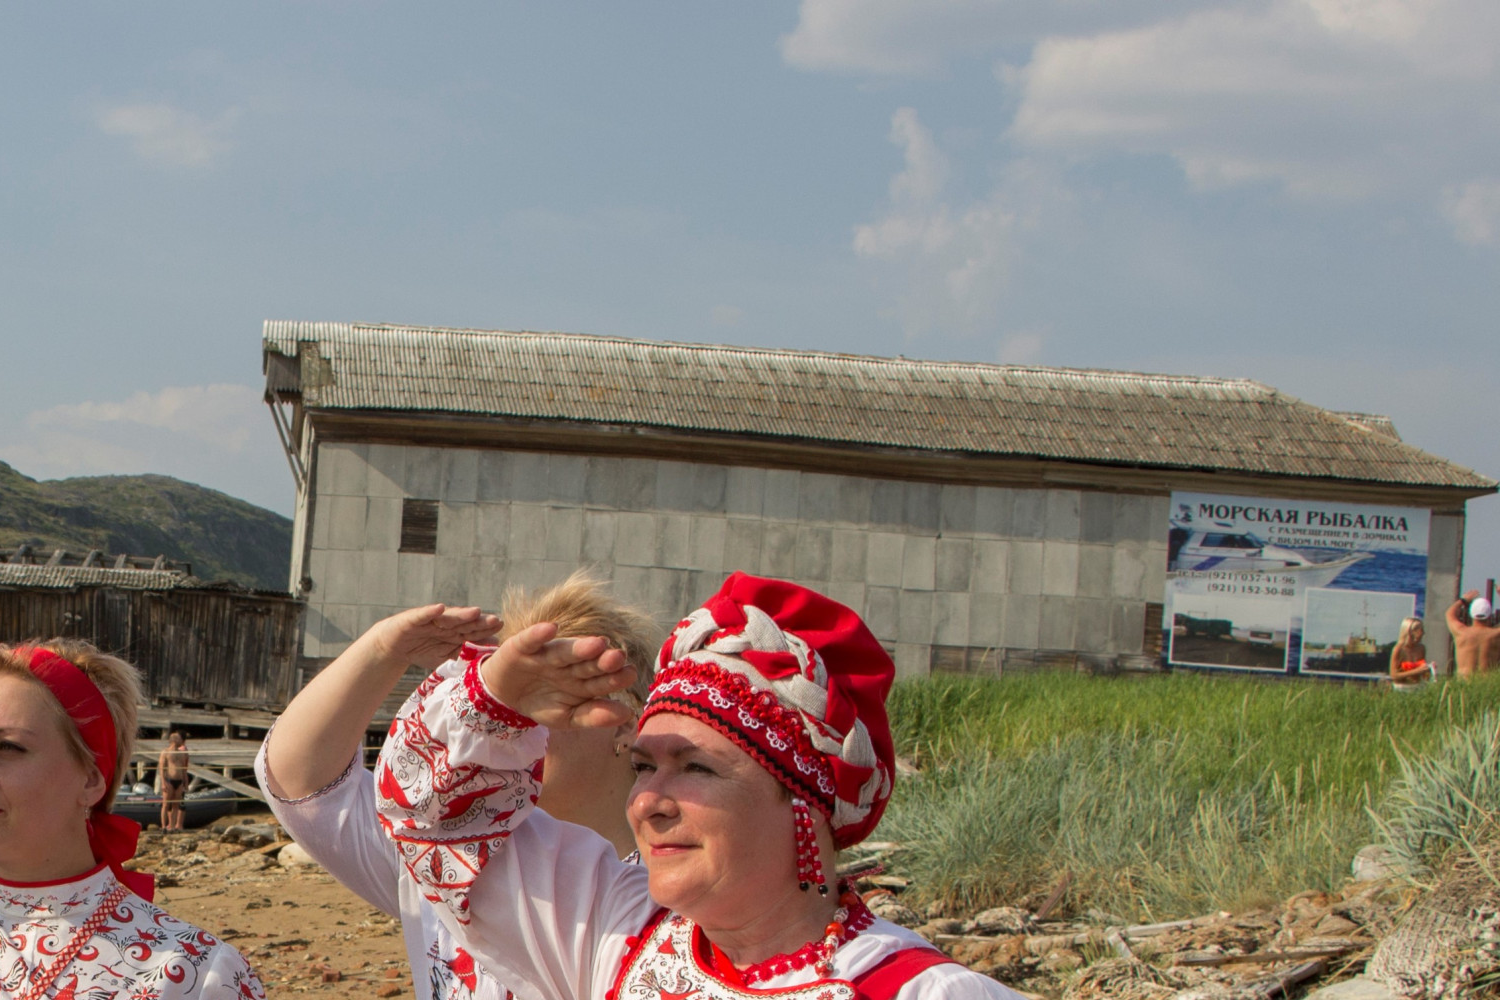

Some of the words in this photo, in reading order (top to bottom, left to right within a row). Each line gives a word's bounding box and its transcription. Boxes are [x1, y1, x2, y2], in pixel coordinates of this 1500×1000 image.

[1199, 503, 1299, 524] МОРСКАЯ
[1306, 511, 1409, 532] РЫБАЛКА
[1268, 526, 1276, 534] С
[1352, 531, 1360, 539] В
[1268, 536, 1276, 545] С
[1314, 538, 1328, 547] НА
[1331, 540, 1356, 549] МОРЕ
[1208, 571, 1238, 582] (921)
[1207, 582, 1237, 594] (921)
